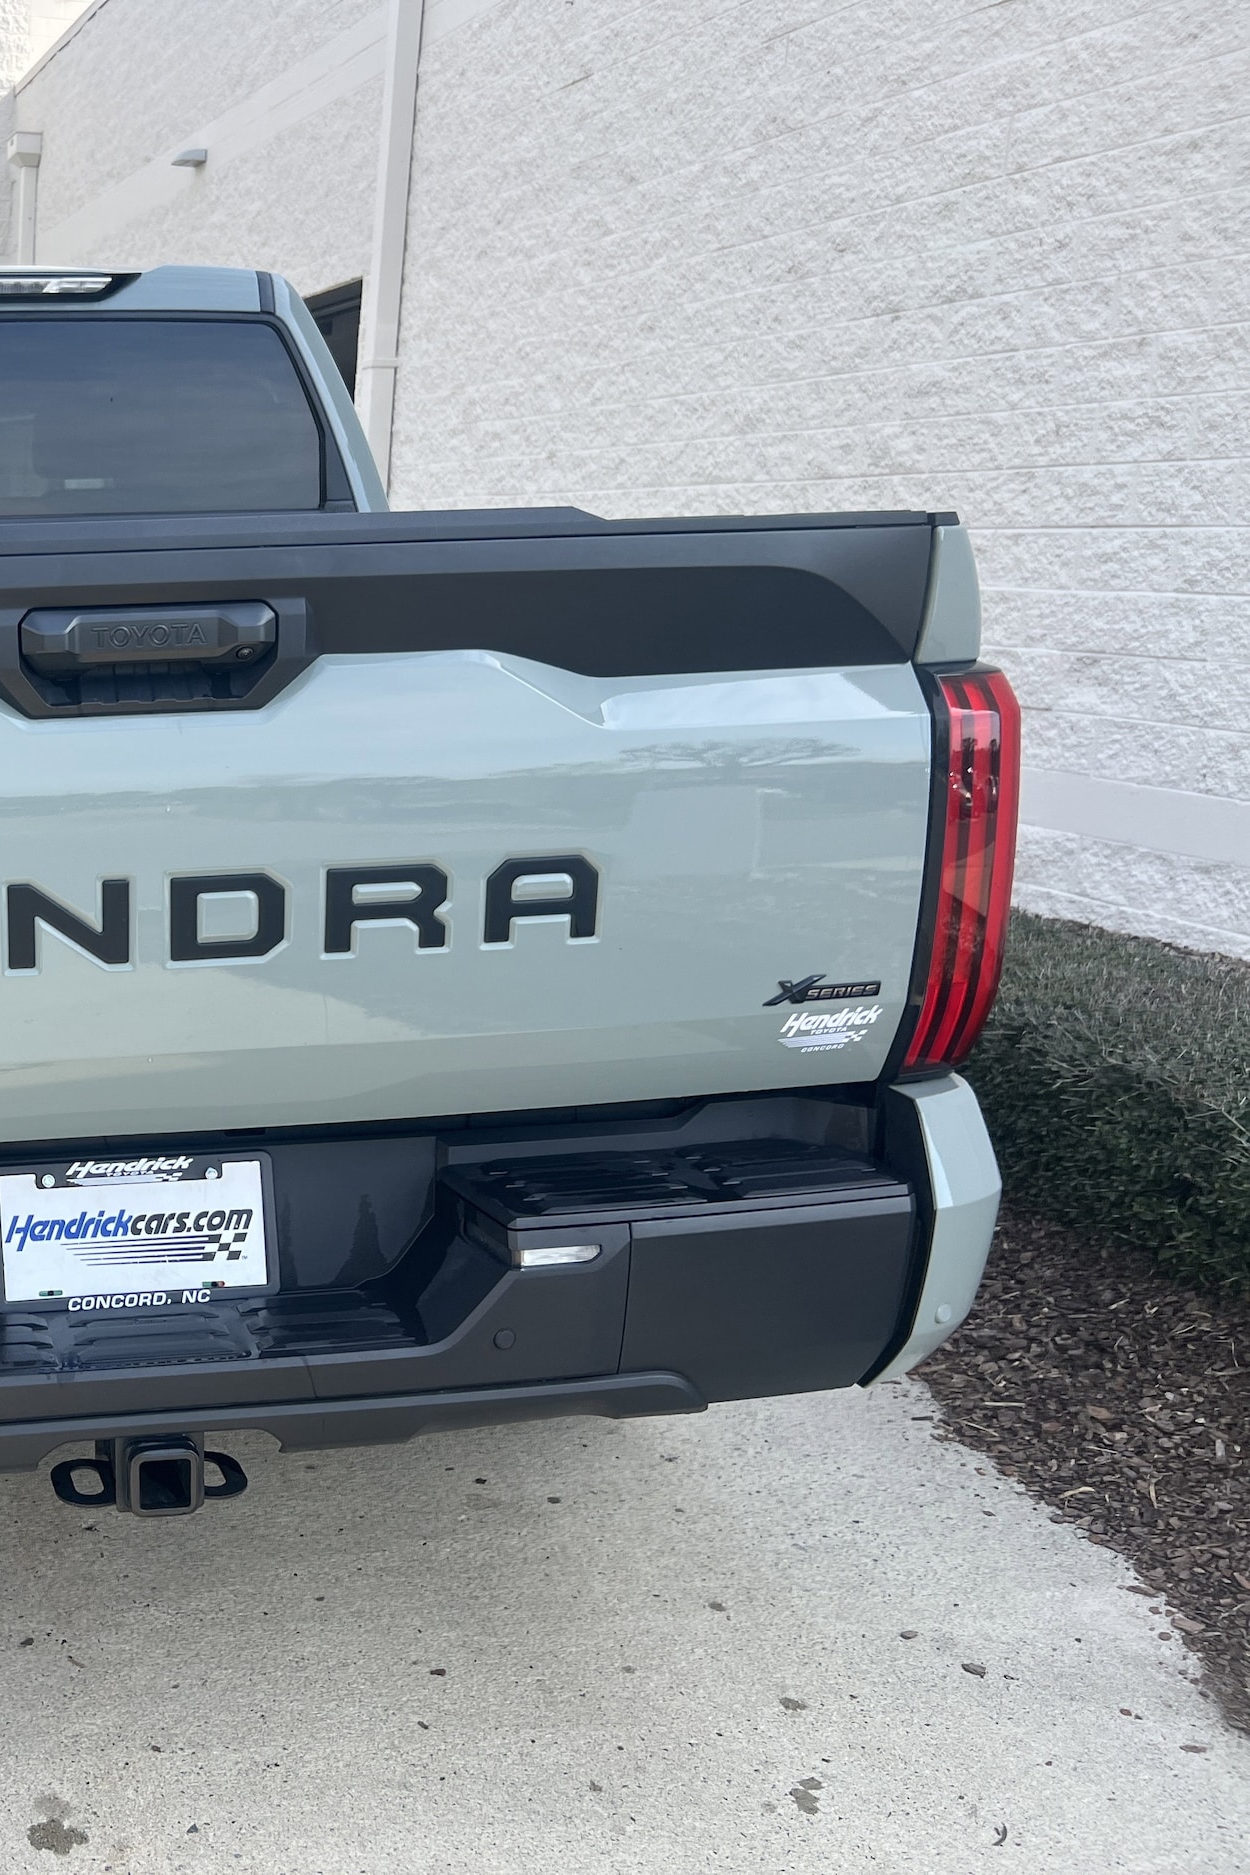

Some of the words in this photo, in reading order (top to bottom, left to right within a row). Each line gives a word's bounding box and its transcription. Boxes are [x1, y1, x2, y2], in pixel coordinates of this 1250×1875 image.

[91, 622, 207, 649] TOYOTA
[779, 1004, 884, 1038] Hendrick
[809, 1026, 848, 1036] TOYOTA
[800, 1043, 845, 1053] CONCORD
[65, 1155, 194, 1179] Hendrick
[4, 1208, 254, 1252] Hendrickcars.com
[67, 1291, 173, 1313] CONCORD,
[181, 1289, 212, 1304] NC
